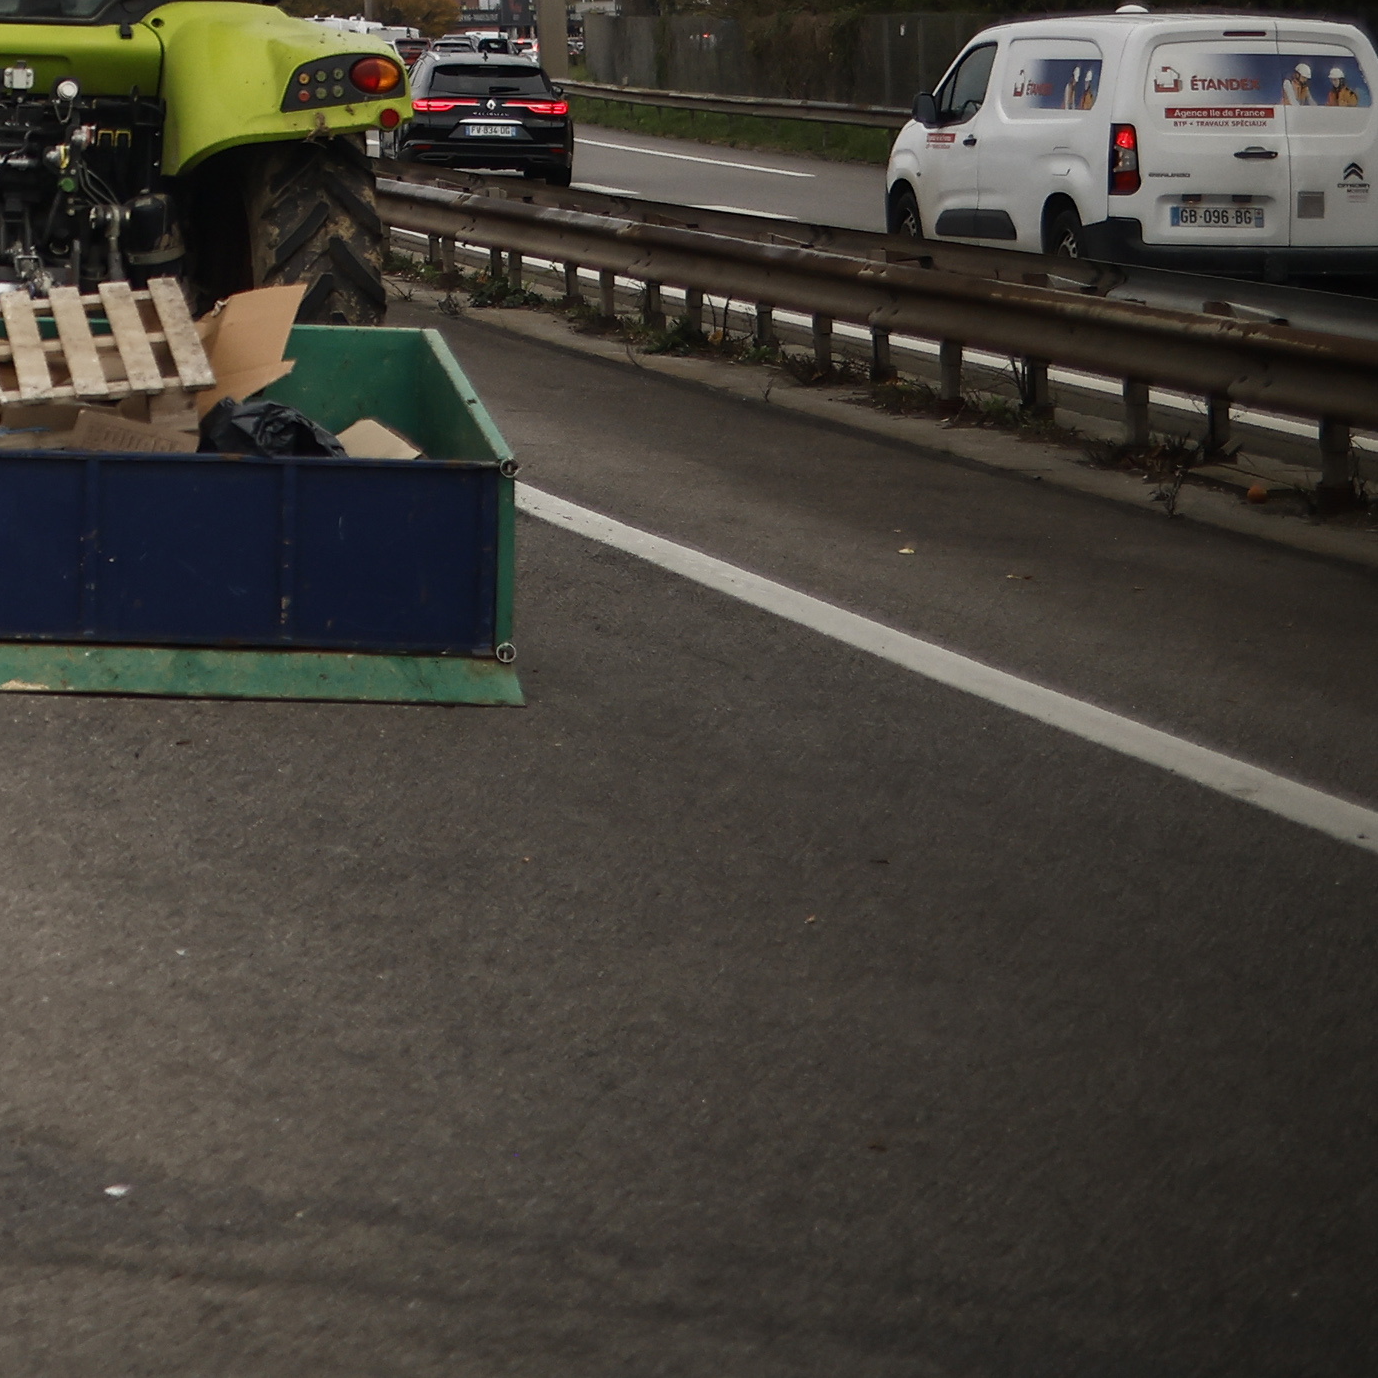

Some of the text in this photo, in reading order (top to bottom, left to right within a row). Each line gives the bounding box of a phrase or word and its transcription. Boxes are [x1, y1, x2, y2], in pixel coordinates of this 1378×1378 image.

[1190, 75, 1261, 91] ÉTANDEX
[1174, 109, 1208, 118] Agence
[1222, 109, 1233, 117] de
[1235, 109, 1265, 117] France
[1180, 209, 1252, 224] GB-096-BG
